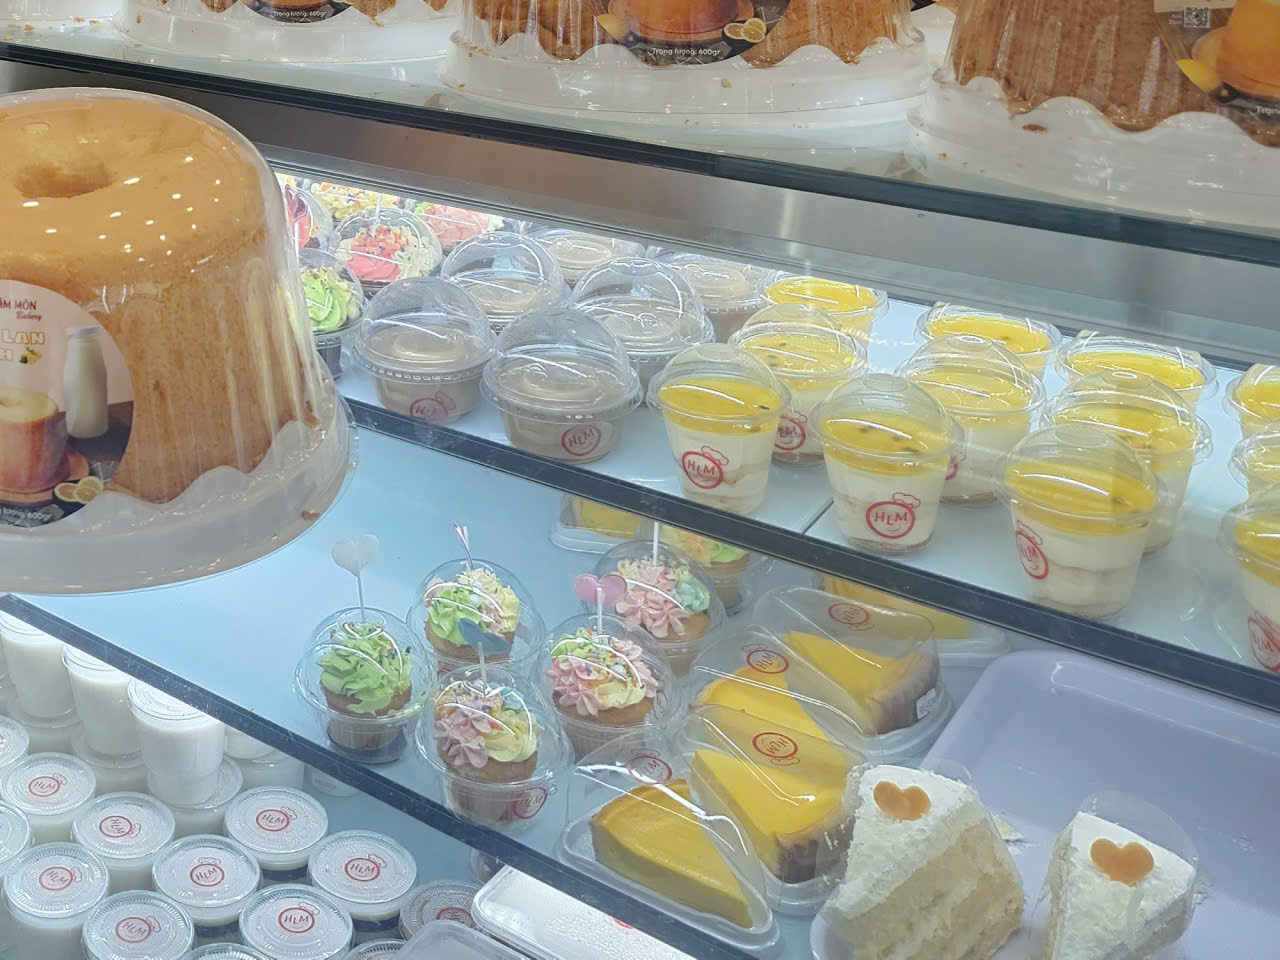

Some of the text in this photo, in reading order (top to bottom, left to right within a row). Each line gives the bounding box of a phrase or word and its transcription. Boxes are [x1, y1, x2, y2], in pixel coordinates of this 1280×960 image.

[698, 48, 721, 57] 600gr
[1, 327, 46, 345] LAN
[568, 427, 594, 447] HLM
[687, 459, 716, 476] HLM
[873, 511, 908, 525] HLM
[756, 651, 776, 670] HLM
[766, 737, 790, 755] HLM
[33, 780, 57, 790] HLM
[110, 818, 126, 834] HLM
[261, 813, 285, 824] HLM
[195, 866, 218, 881] HLM
[350, 862, 375, 873] HLM
[46, 870, 69, 885] HLM
[284, 914, 309, 924] HLM
[122, 920, 147, 936] HLM
